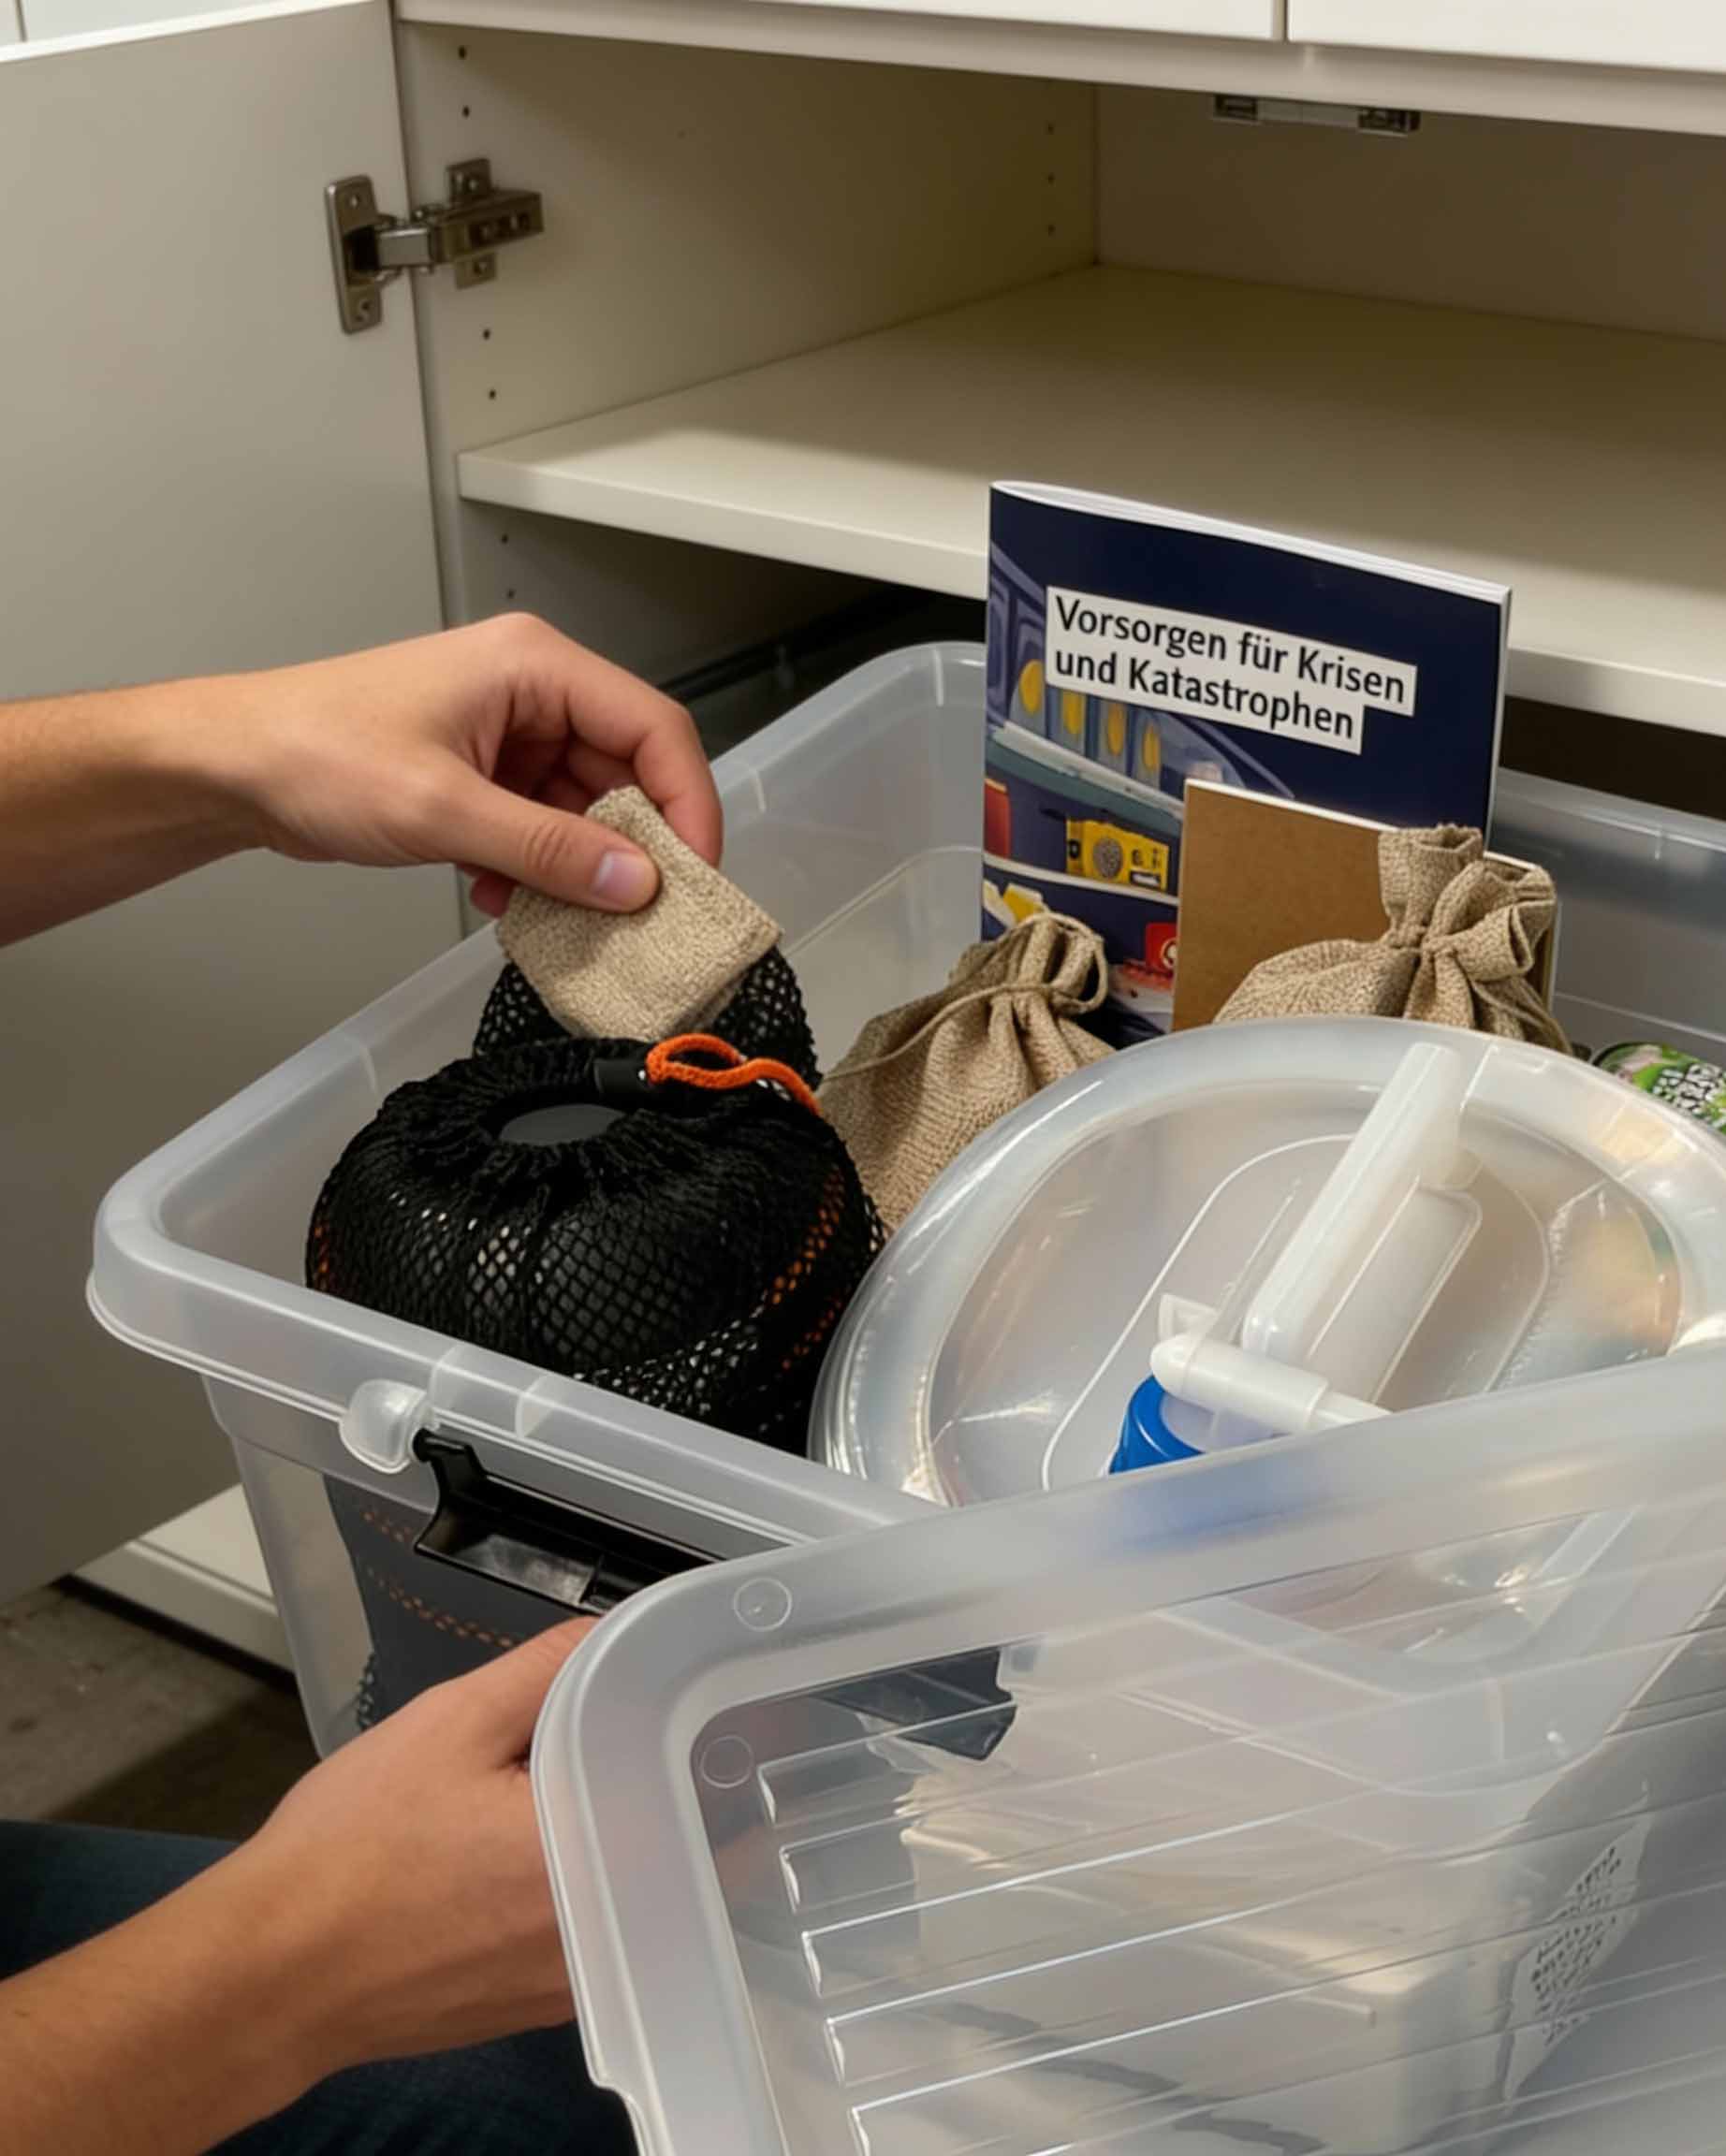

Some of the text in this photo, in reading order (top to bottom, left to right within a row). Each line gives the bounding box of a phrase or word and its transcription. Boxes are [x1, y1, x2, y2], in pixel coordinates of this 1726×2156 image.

[1055, 595, 1405, 705] Vorsorgen für Krisen
[1055, 650, 1354, 739] und Katastrophen
